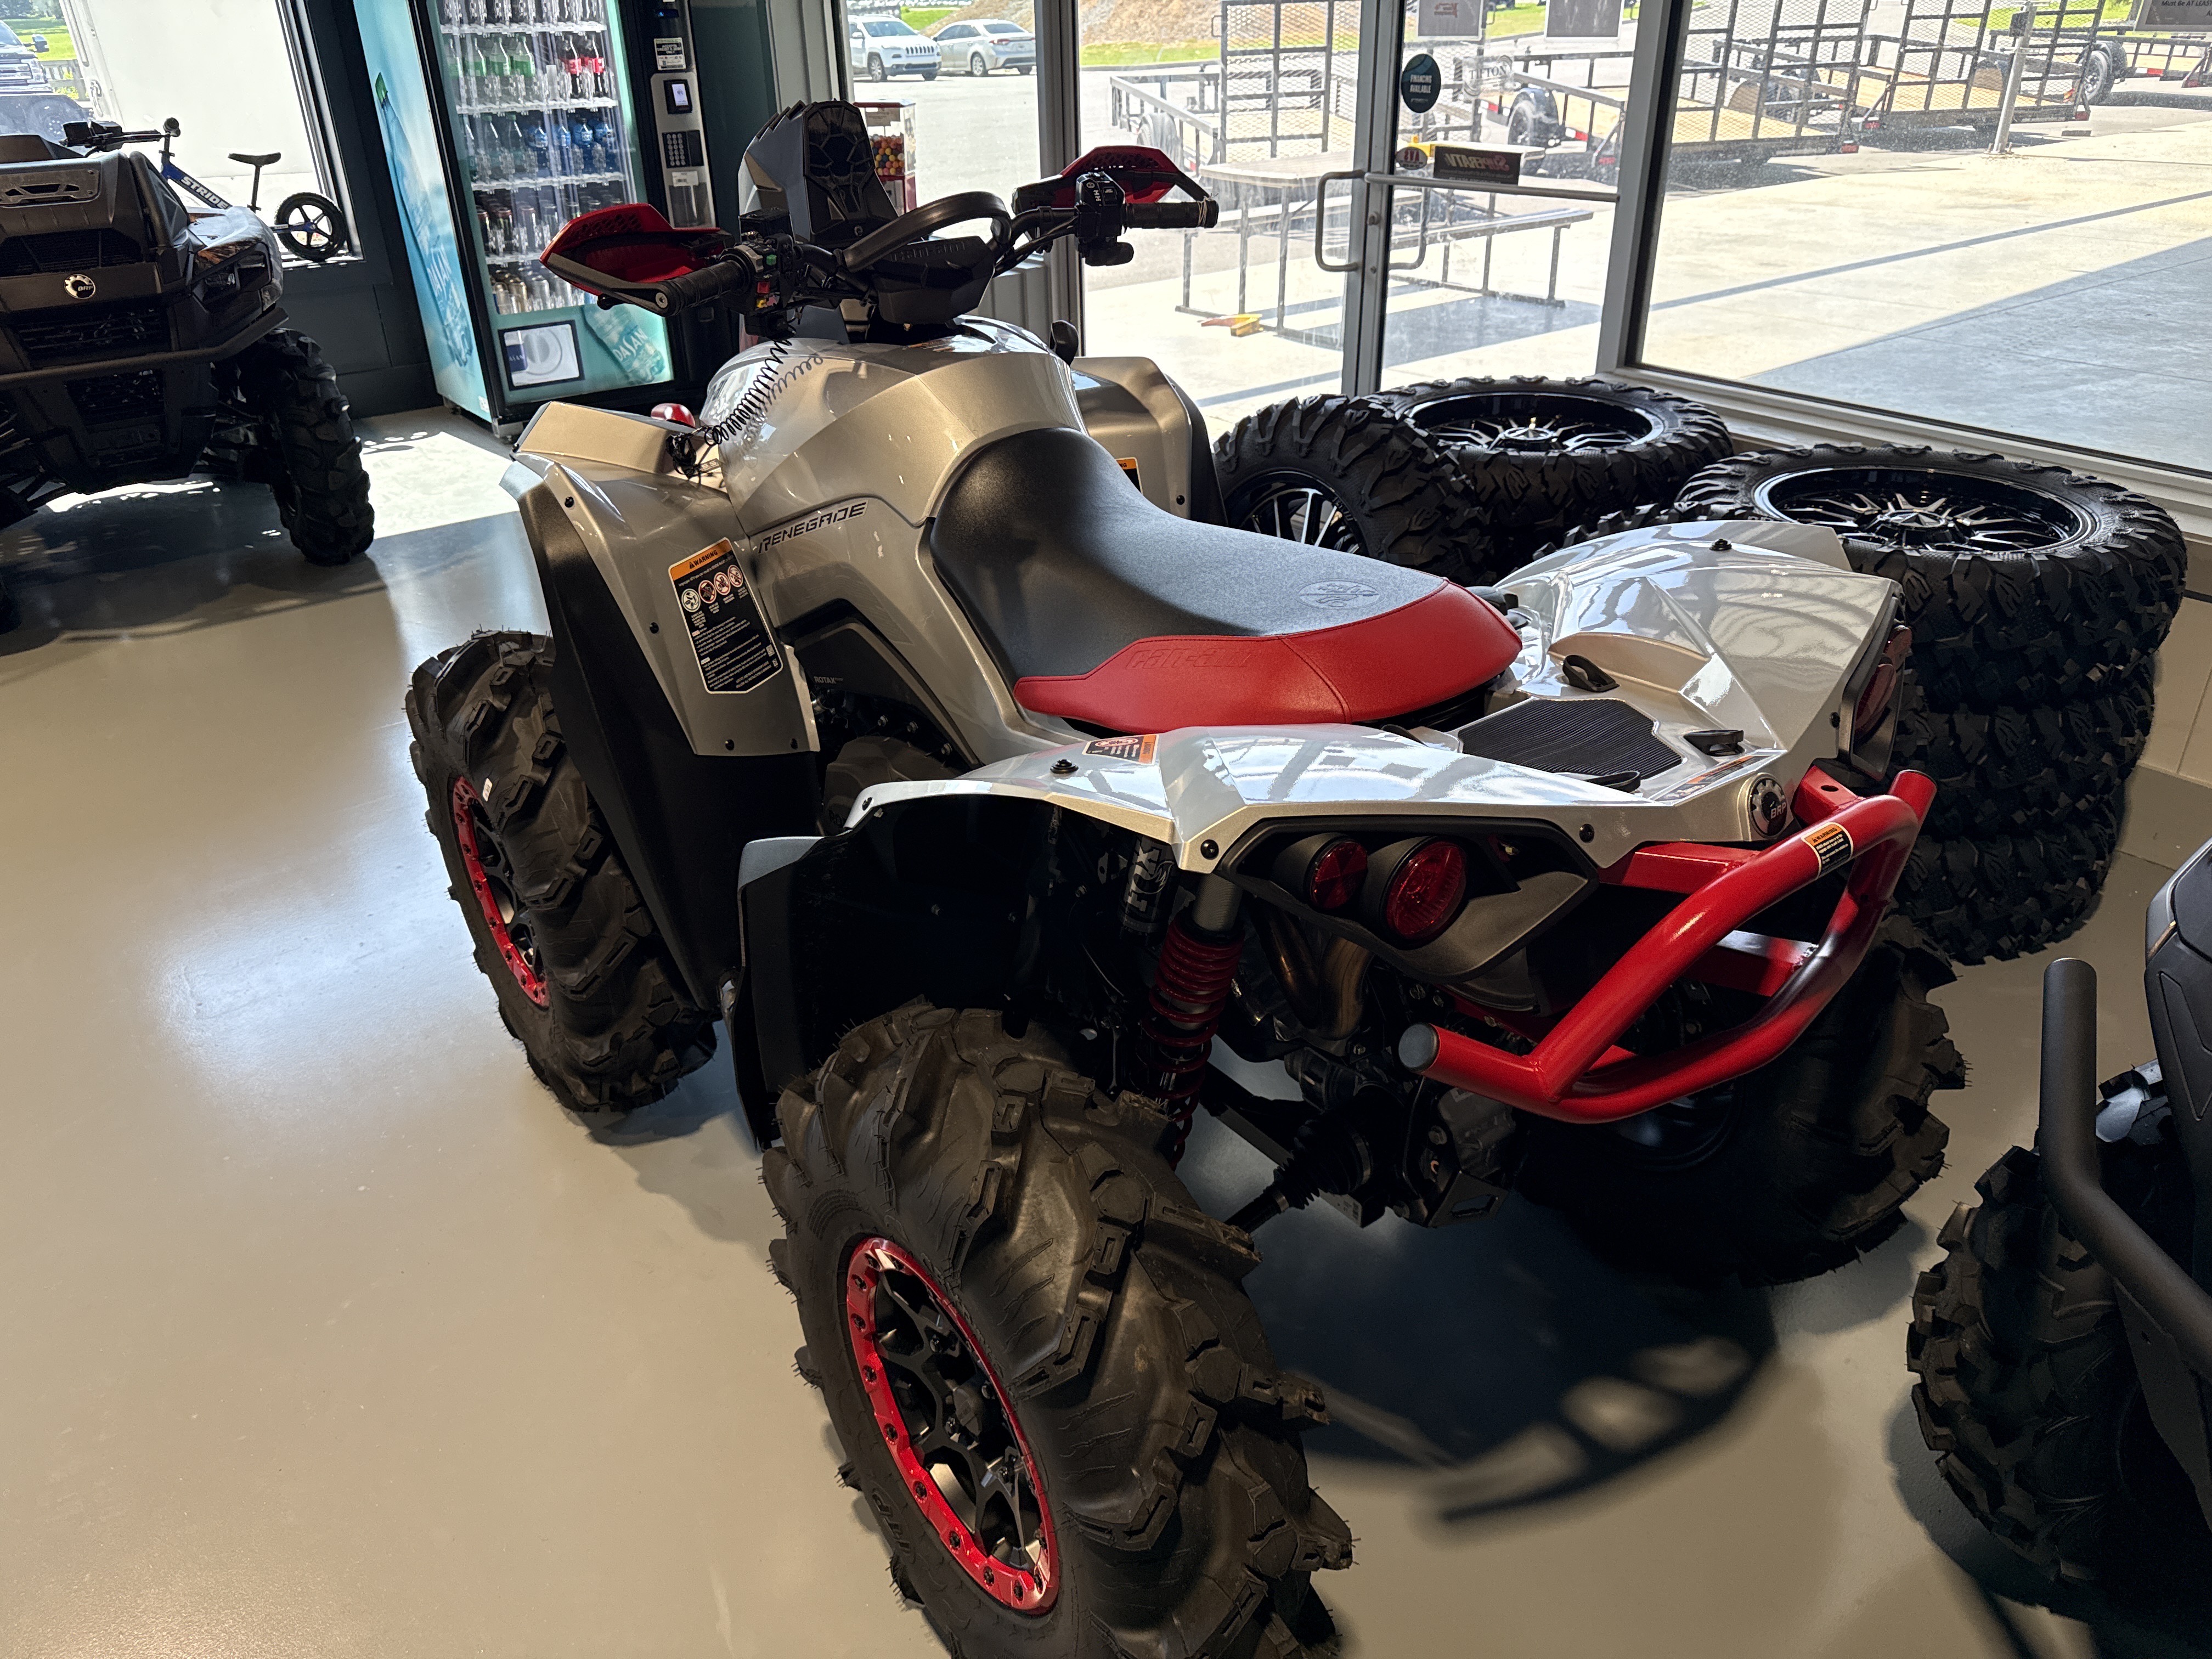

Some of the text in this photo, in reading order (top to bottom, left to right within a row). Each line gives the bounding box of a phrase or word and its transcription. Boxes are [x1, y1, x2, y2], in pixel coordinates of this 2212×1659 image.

[1469, 65, 1507, 80] TIFTON
[1409, 84, 1431, 93] AVAILABLE
[758, 501, 867, 554] RENEGADE
[693, 550, 718, 566] WARNING
[814, 676, 836, 684] ROTAX
[1770, 801, 1787, 819] BRP
[1815, 827, 1838, 842] WARNING
[1124, 836, 1161, 912] FOX
